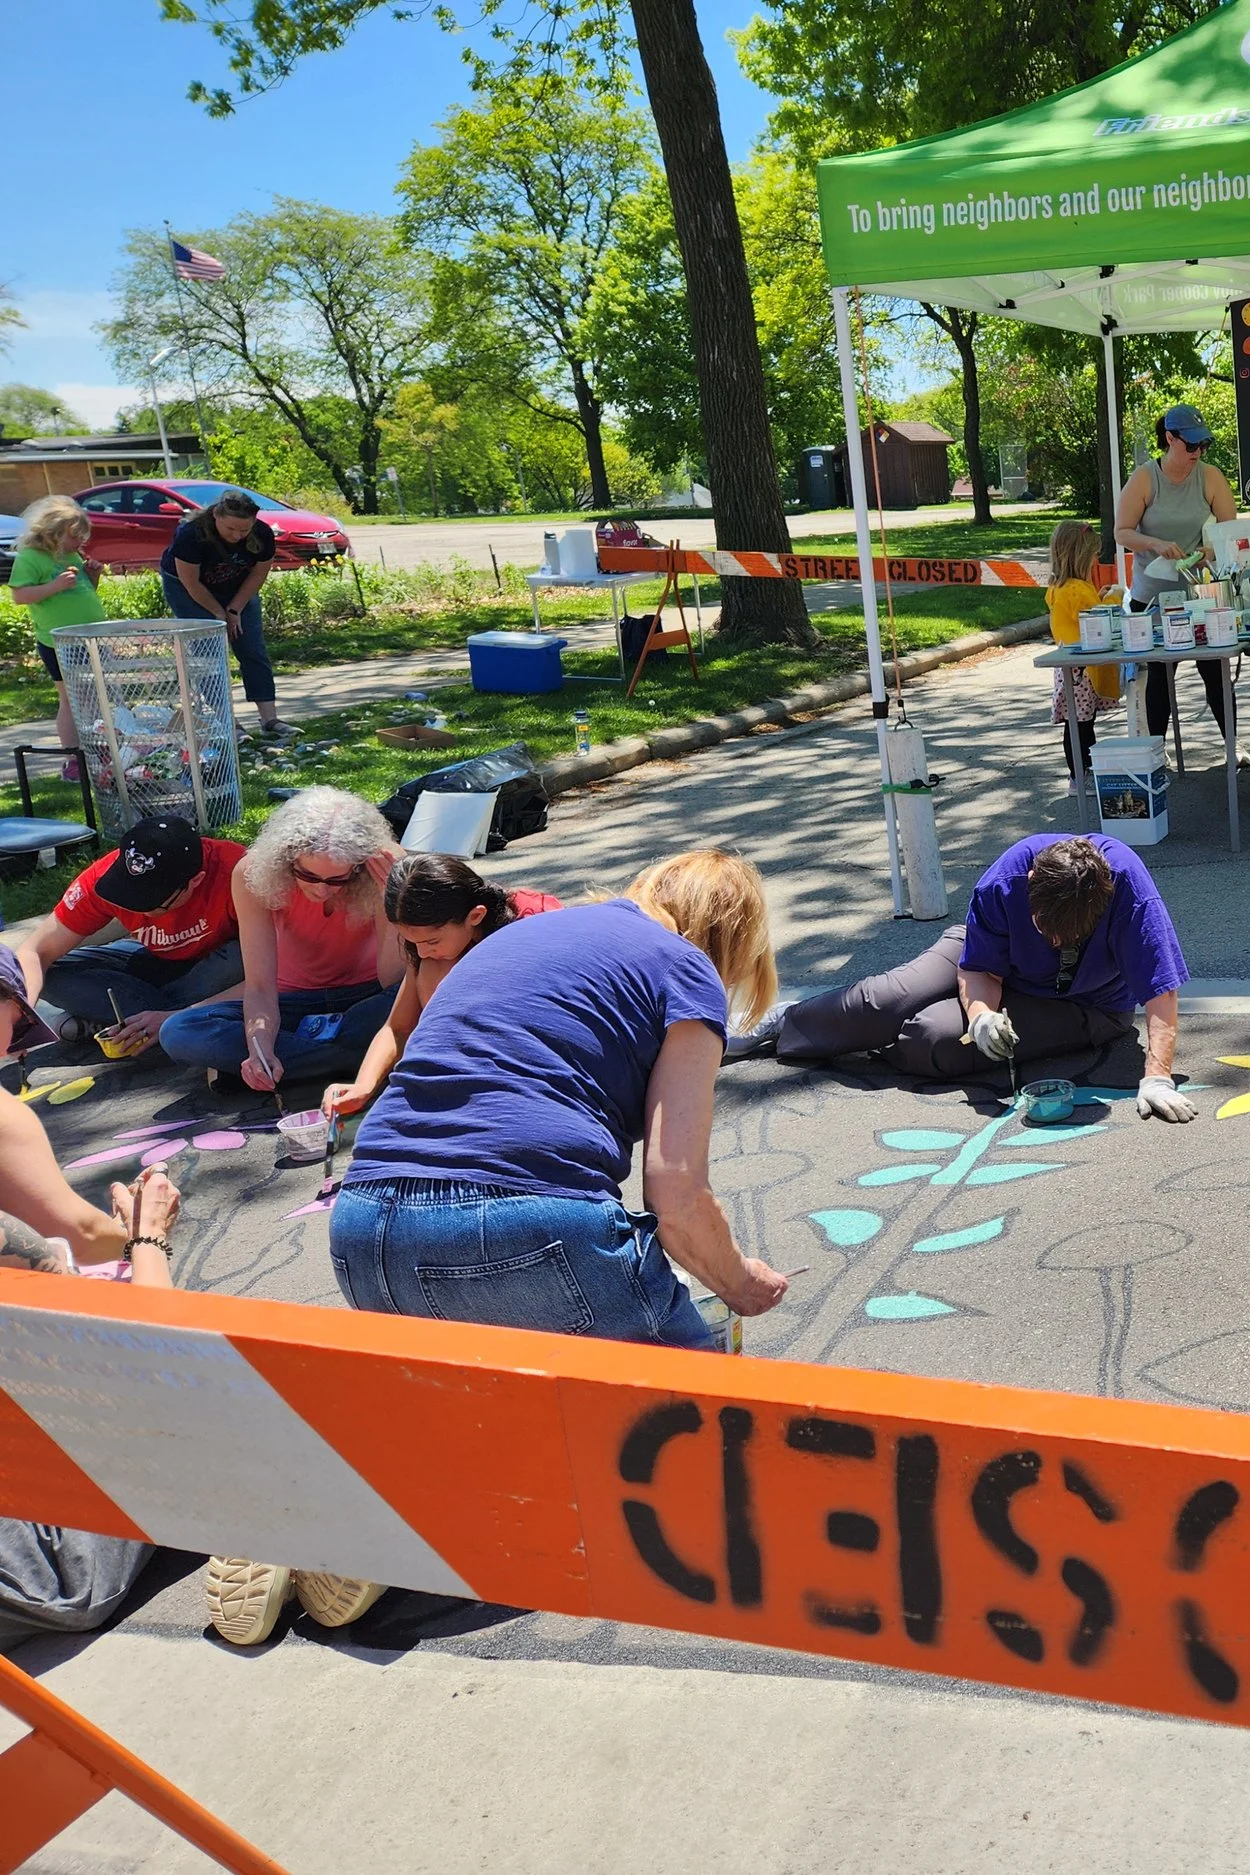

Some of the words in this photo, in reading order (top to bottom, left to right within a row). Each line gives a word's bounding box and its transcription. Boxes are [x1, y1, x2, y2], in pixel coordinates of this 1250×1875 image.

[847, 204, 872, 234] To
[877, 199, 936, 235] bring
[942, 193, 1053, 231] neighbors
[1059, 183, 1101, 218] and
[1107, 185, 1146, 213] our
[784, 557, 861, 580] STREE
[888, 559, 978, 583] CLOSED
